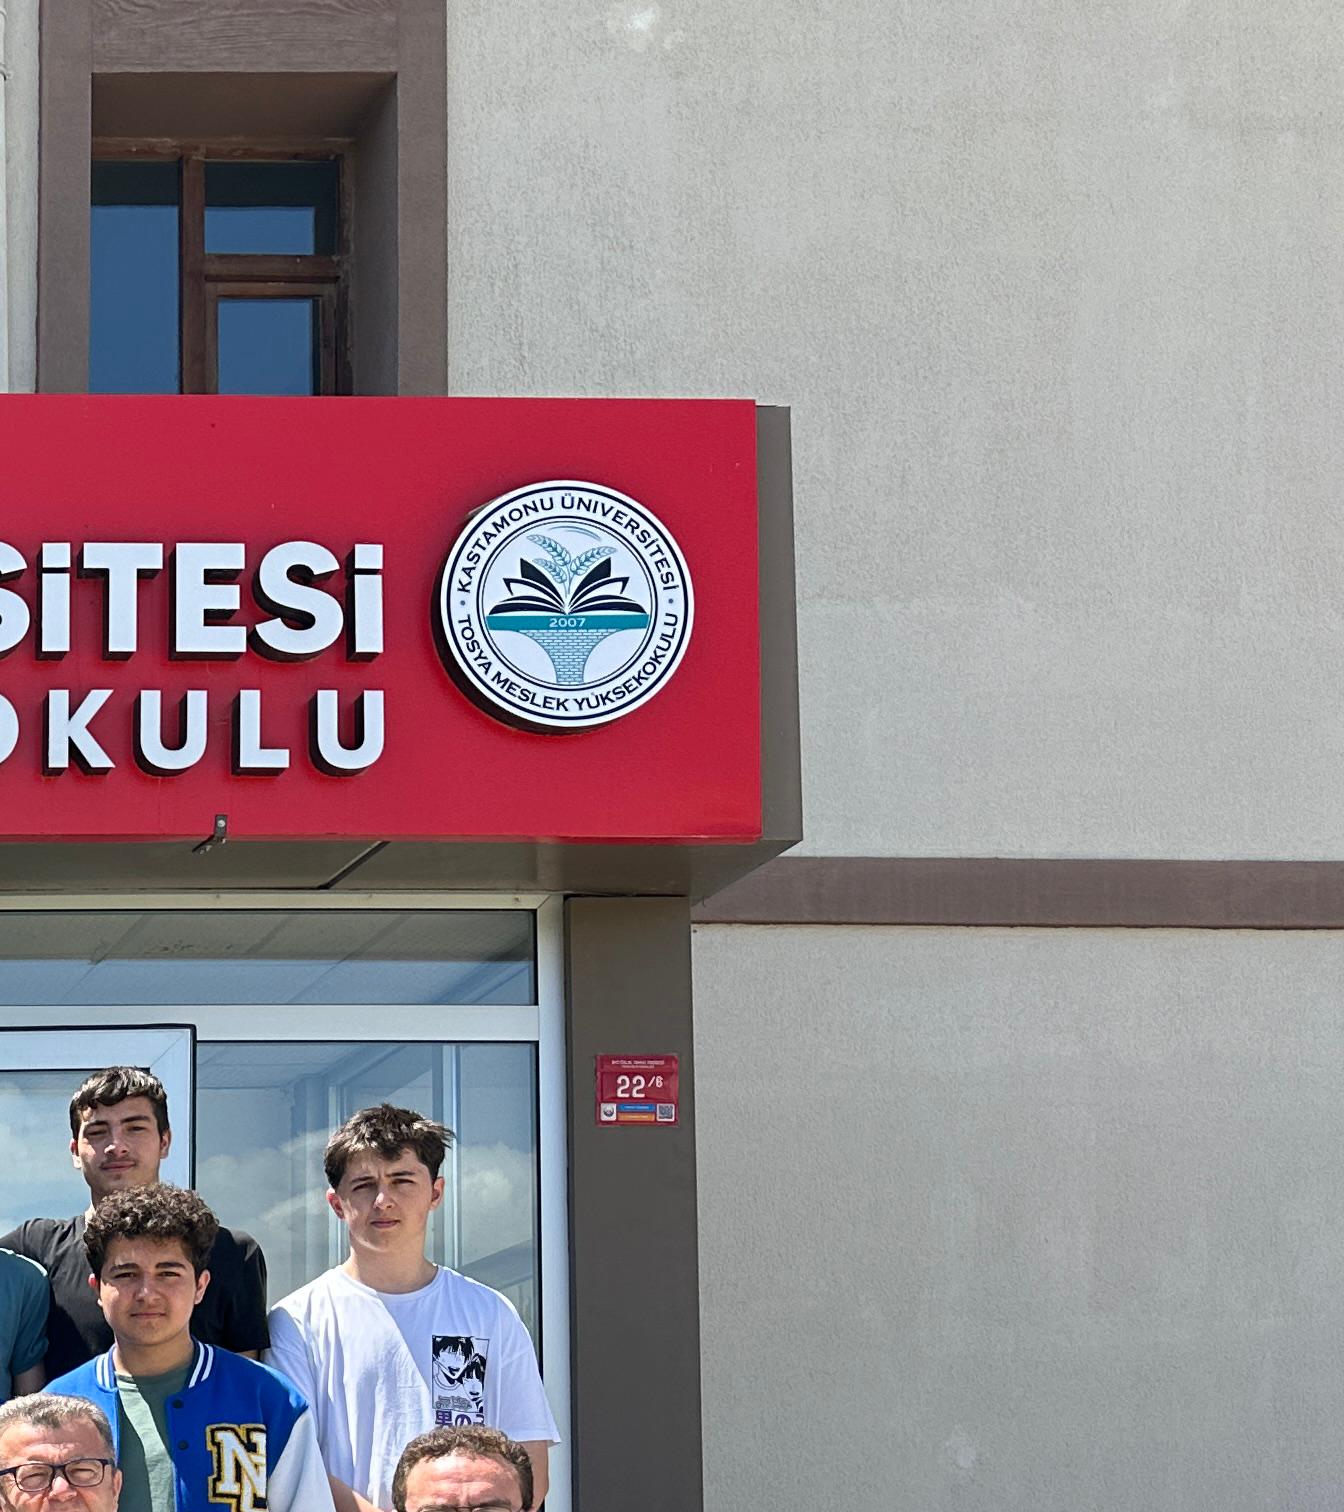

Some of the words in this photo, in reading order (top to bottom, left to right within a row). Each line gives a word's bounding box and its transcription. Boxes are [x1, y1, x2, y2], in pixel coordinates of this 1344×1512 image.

[456, 496, 555, 593] KASTAMONU
[457, 613, 494, 676] TOSYA
[491, 670, 571, 712] MESLEK
[548, 617, 586, 628] 2007
